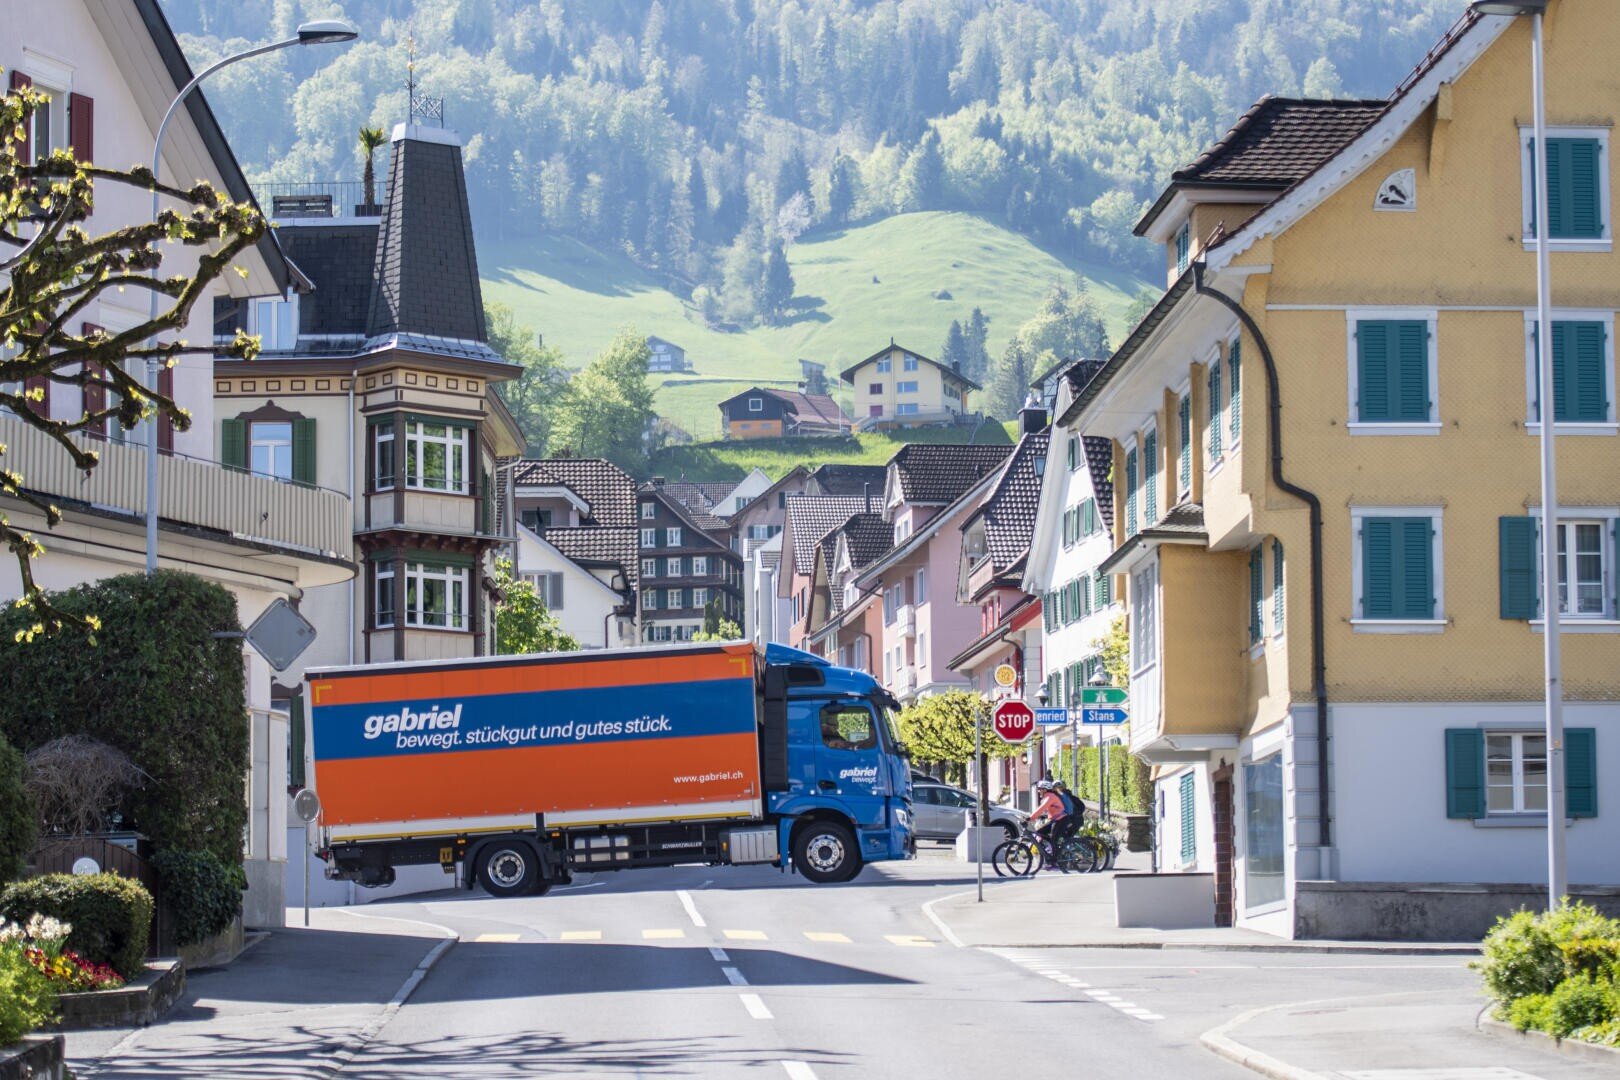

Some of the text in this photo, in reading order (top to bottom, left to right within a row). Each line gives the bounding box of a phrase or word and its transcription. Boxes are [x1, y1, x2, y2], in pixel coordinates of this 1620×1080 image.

[364, 704, 462, 739] gabriel
[998, 714, 1031, 728] STOP
[1036, 710, 1065, 722] enried
[1088, 710, 1115, 722] Stans
[396, 714, 672, 748] bewegt. stückgut und gutes stück.
[673, 771, 744, 783] www.gabriel.ch
[840, 766, 878, 779] gabriel
